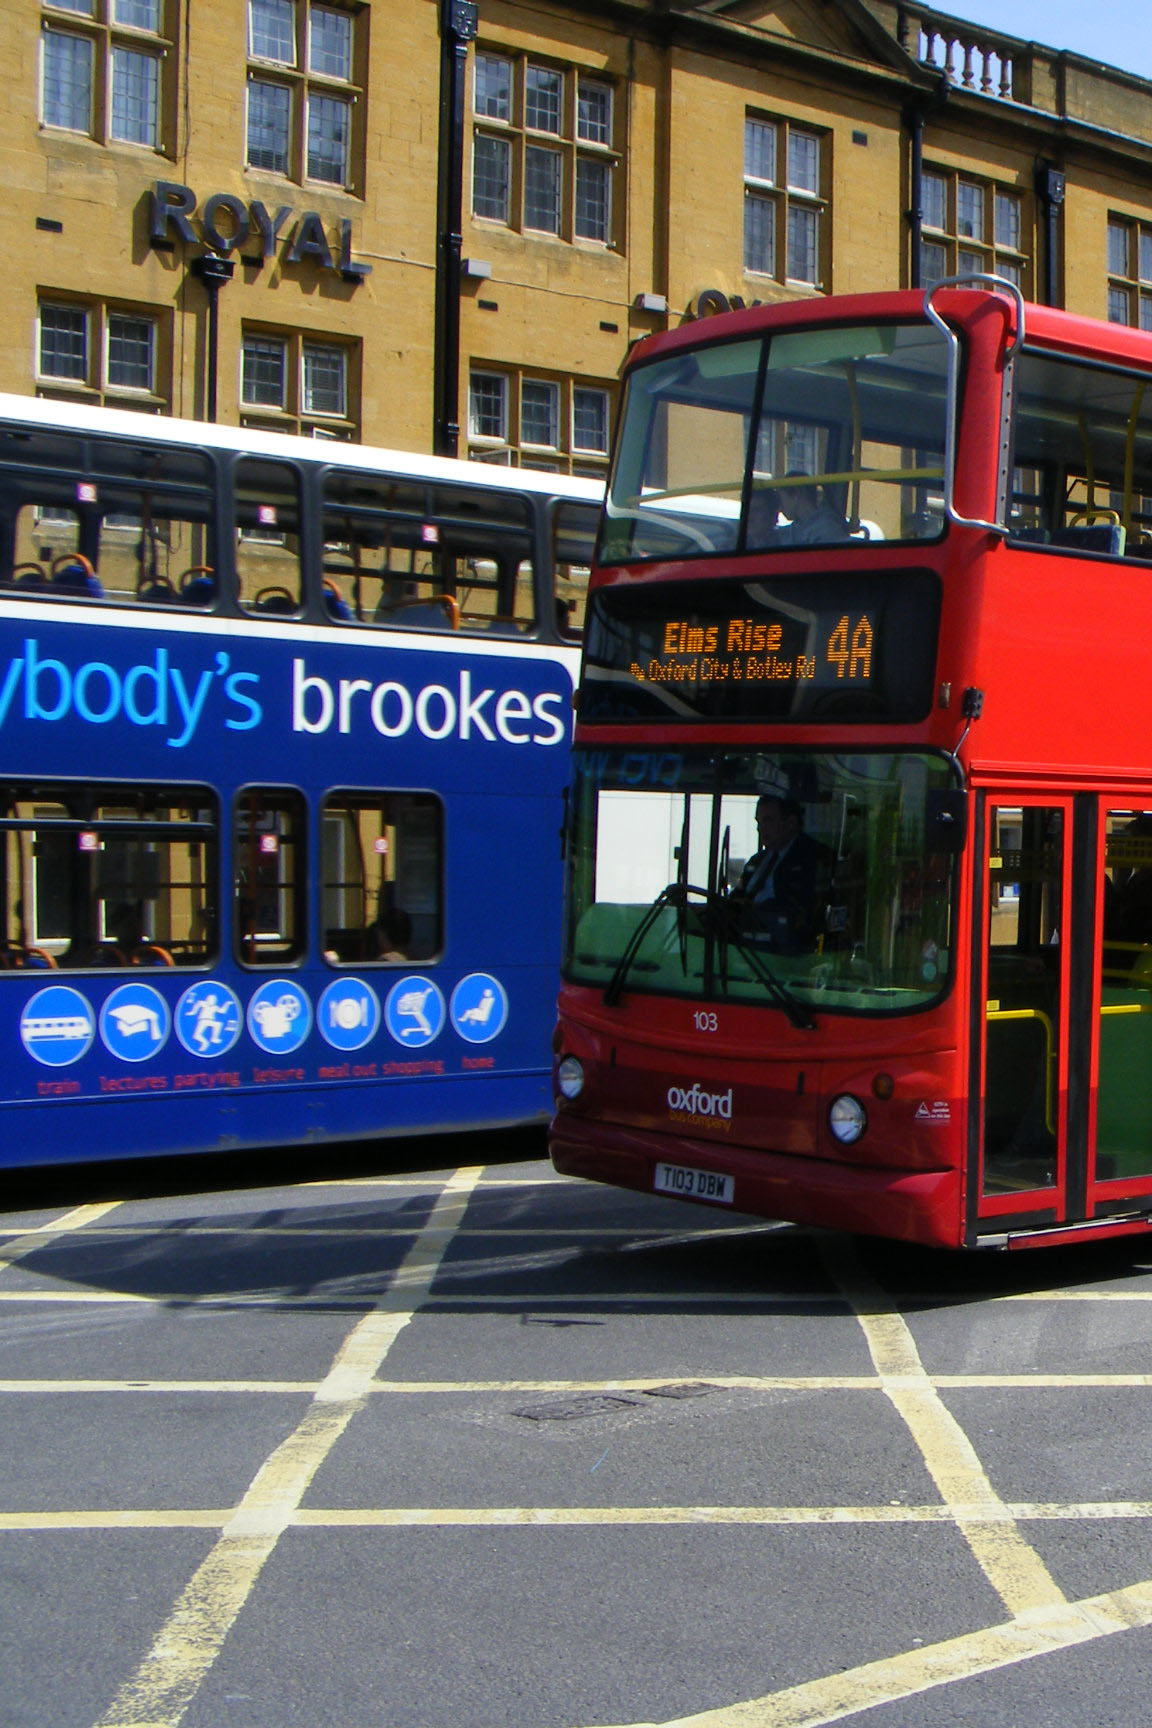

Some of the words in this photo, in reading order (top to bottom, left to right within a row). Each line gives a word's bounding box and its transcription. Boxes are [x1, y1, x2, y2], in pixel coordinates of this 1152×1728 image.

[154, 180, 373, 276] ROYAL
[664, 621, 718, 654] Elms
[726, 619, 783, 652] Rise
[826, 615, 874, 679] 4A
[649, 658, 698, 681] Oxford
[700, 656, 729, 680] City
[746, 656, 792, 680] Botley
[796, 655, 816, 679] Rd
[293, 658, 565, 747] brookes
[693, 1011, 718, 1032] 103
[37, 1079, 81, 1095] train
[99, 1075, 167, 1091] lectures
[173, 1070, 240, 1089] partying
[253, 1067, 304, 1082] leisure
[318, 1063, 349, 1078] meal
[353, 1063, 377, 1077] out
[383, 1060, 444, 1076] shopping
[462, 1057, 495, 1069] home
[667, 1083, 733, 1119] oxford
[664, 1166, 695, 1191] T103
